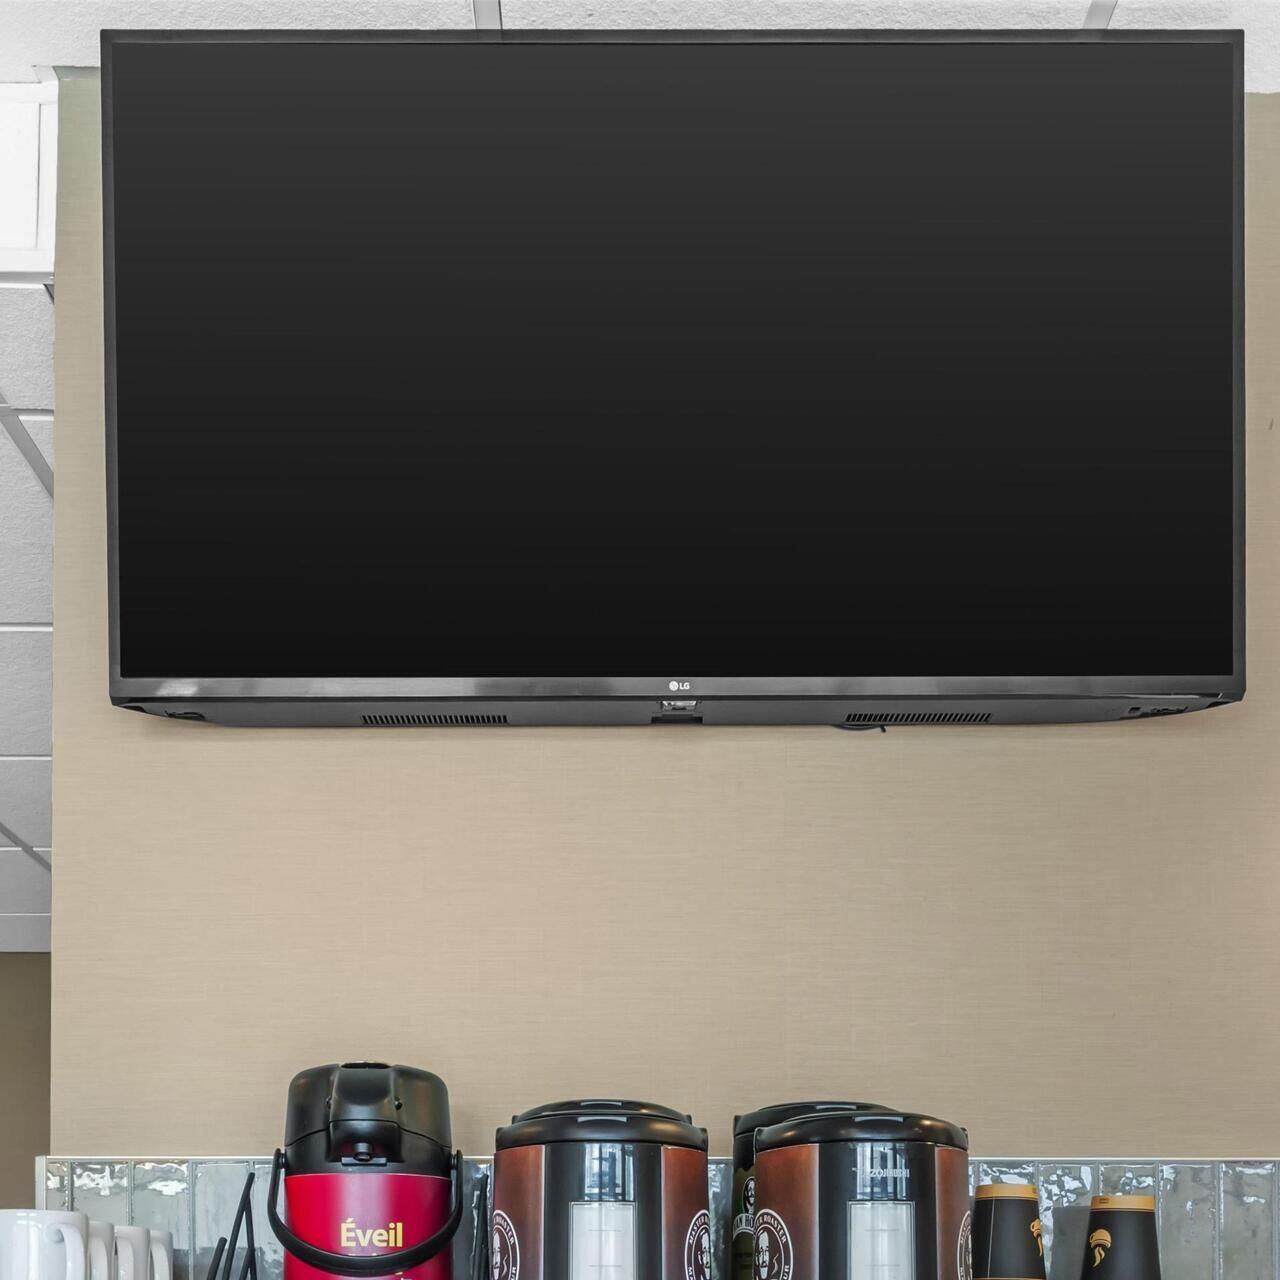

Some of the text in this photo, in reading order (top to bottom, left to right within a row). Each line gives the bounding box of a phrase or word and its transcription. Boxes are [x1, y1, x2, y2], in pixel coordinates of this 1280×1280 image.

[679, 682, 690, 690] LG
[340, 1217, 404, 1248] Éveil
[763, 1214, 787, 1244] ROASTER
